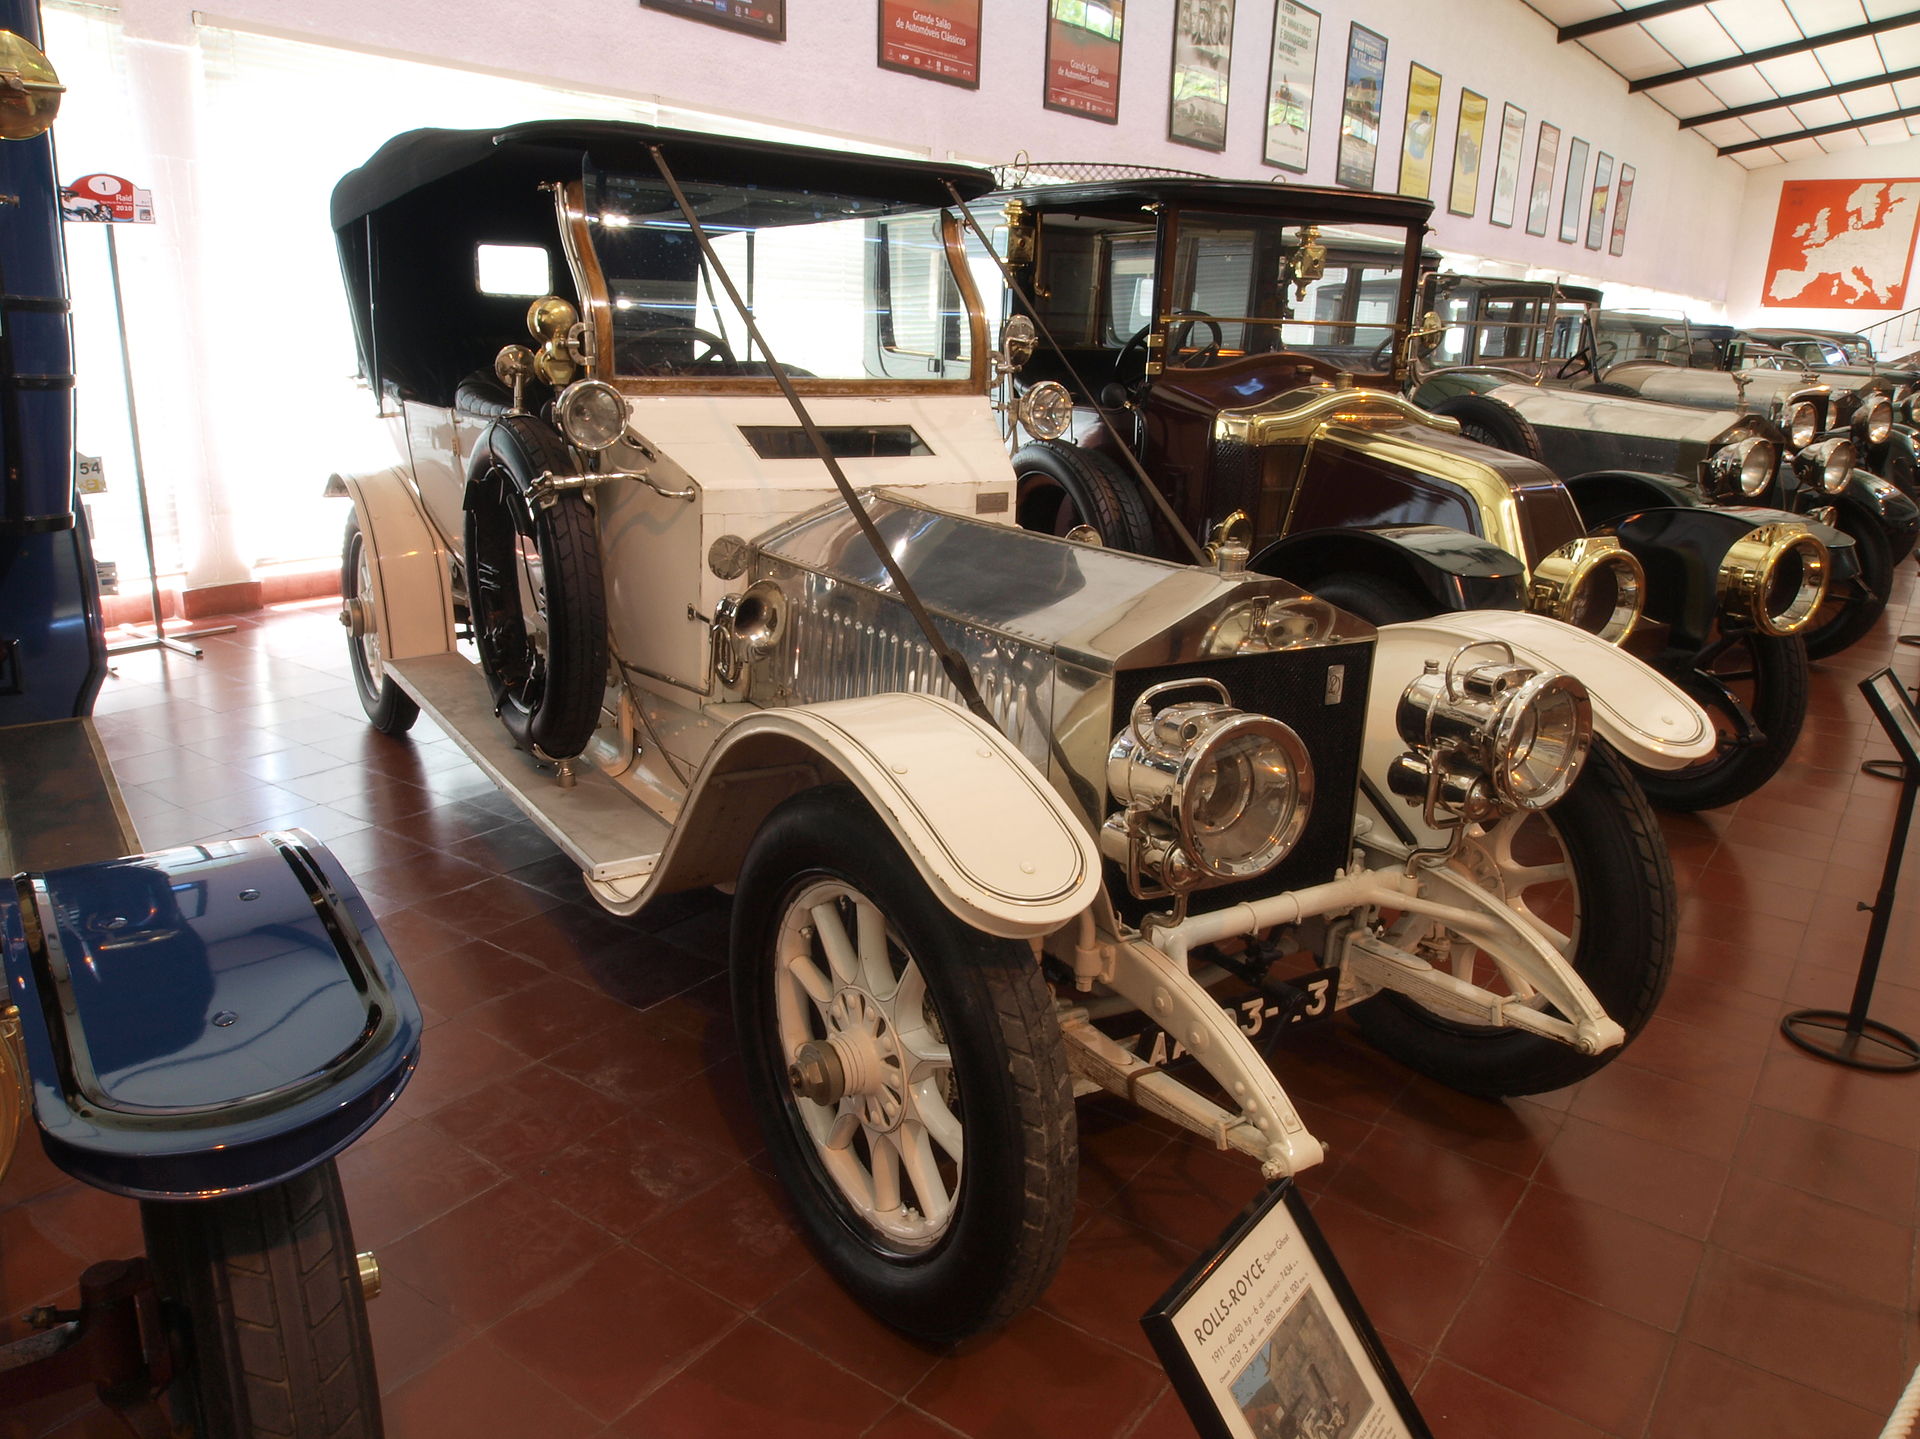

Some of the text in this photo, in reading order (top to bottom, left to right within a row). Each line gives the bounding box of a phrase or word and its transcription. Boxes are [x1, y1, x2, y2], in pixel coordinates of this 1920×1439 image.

[912, 10, 952, 30] Grande Salão
[895, 17, 967, 47] de Automóveis Clássicos
[1057, 66, 1065, 76] de
[1070, 59, 1087, 71] Grande
[101, 181, 106, 191] 1
[115, 193, 133, 202] Raid
[79, 462, 101, 475] 54
[1193, 1258, 1266, 1346] ROLLS-ROYCE
[1263, 1246, 1277, 1264] Silver
[1275, 1233, 1291, 1250] Ghost
[1211, 1345, 1224, 1364] 1911
[1227, 1323, 1244, 1345] 40/50
